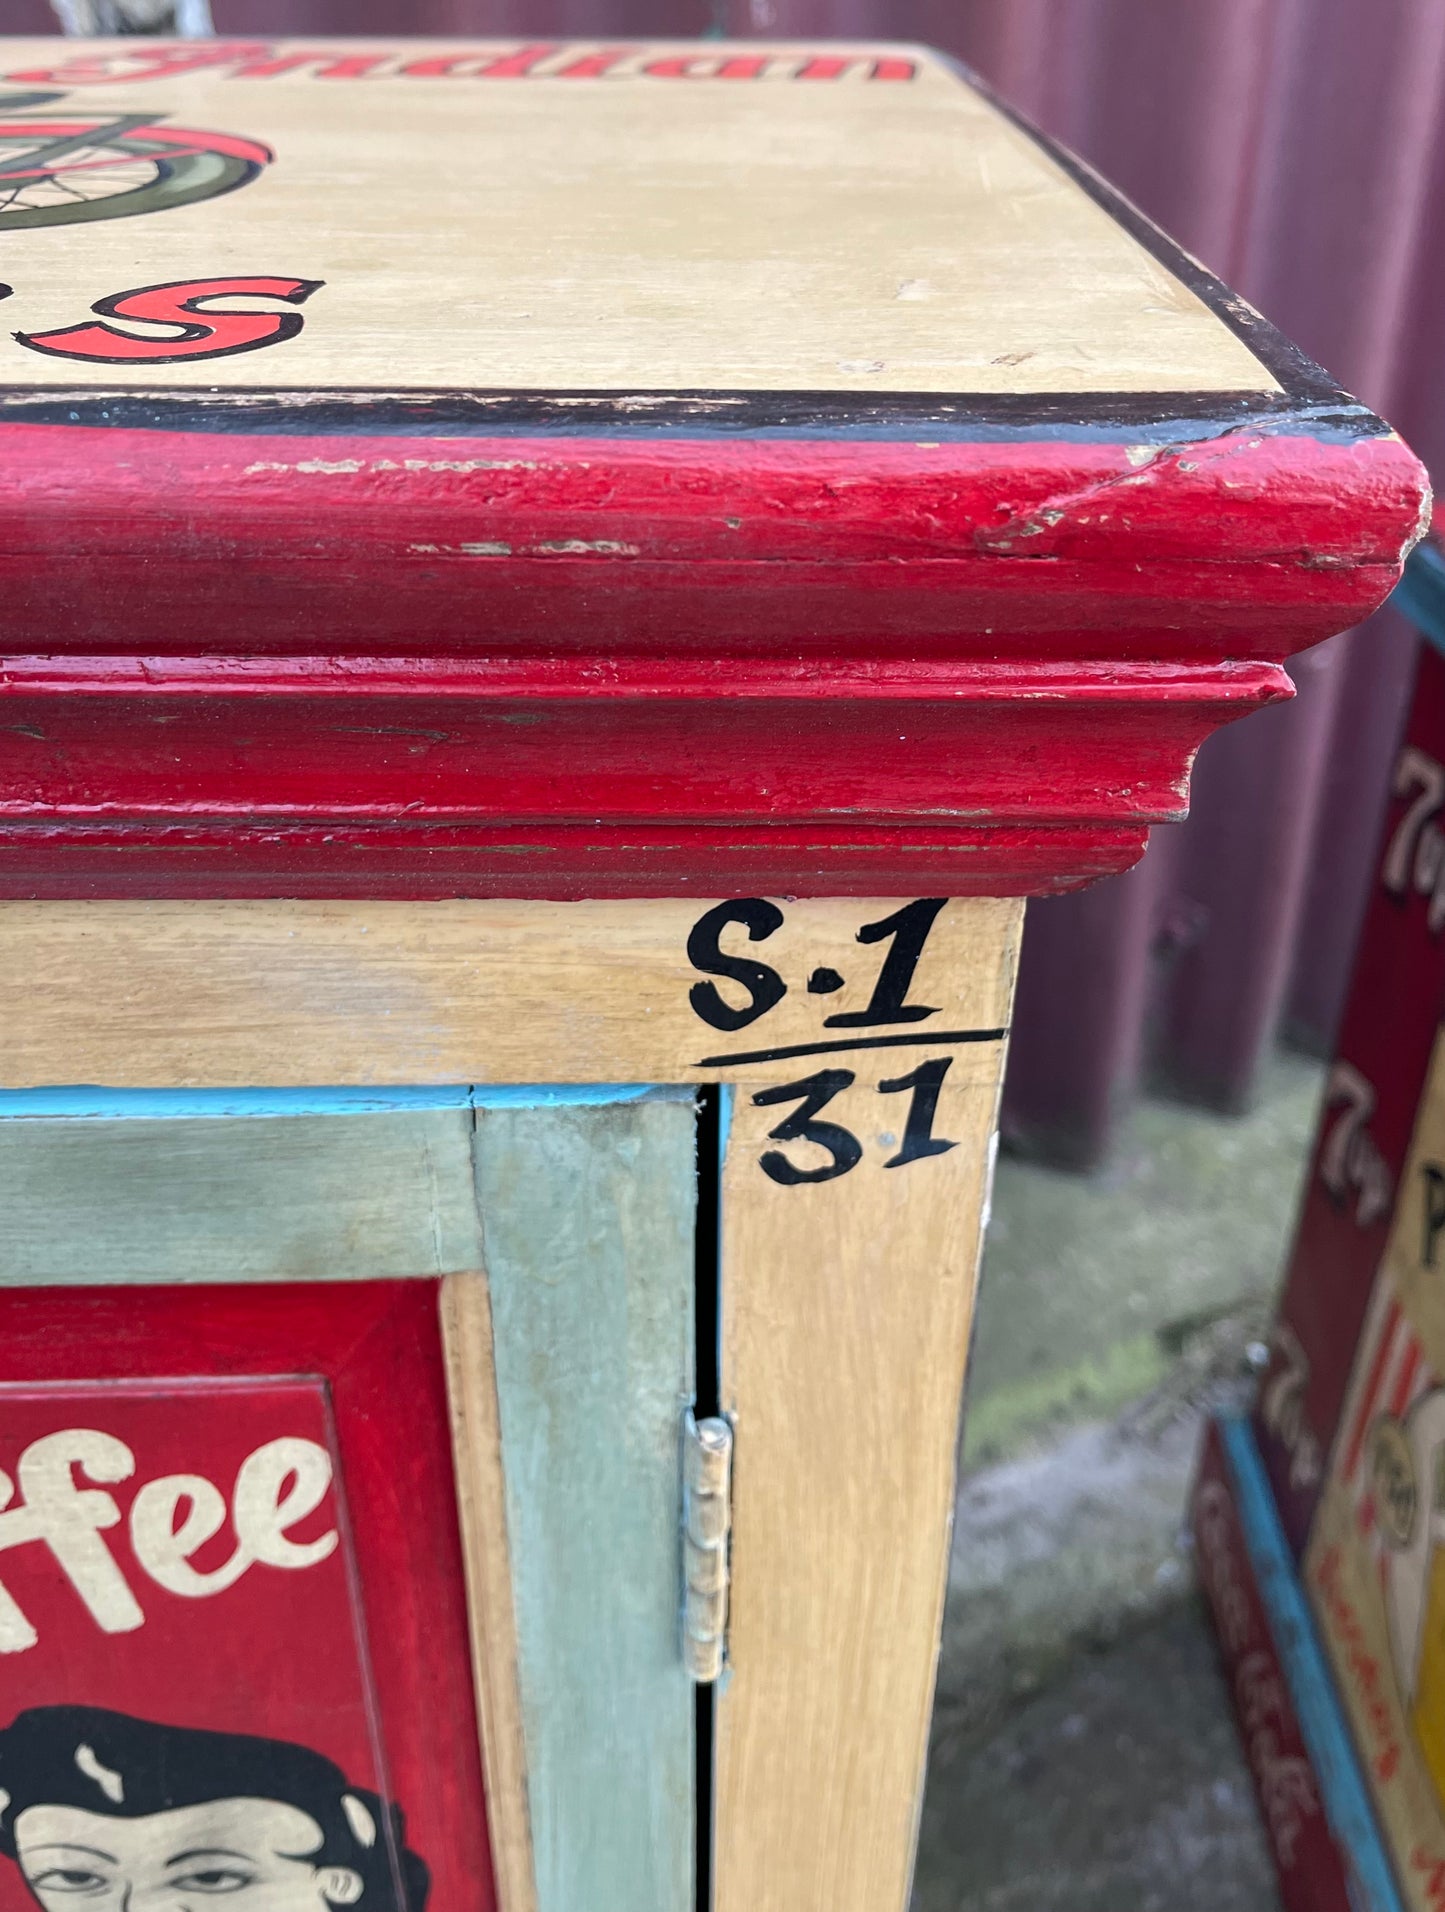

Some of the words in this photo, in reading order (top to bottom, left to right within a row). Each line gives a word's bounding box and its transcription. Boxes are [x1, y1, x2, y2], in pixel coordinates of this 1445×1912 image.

[2, 39, 917, 82] Indian
[0, 276, 326, 365] S
[750, 1057, 960, 1185] 31
